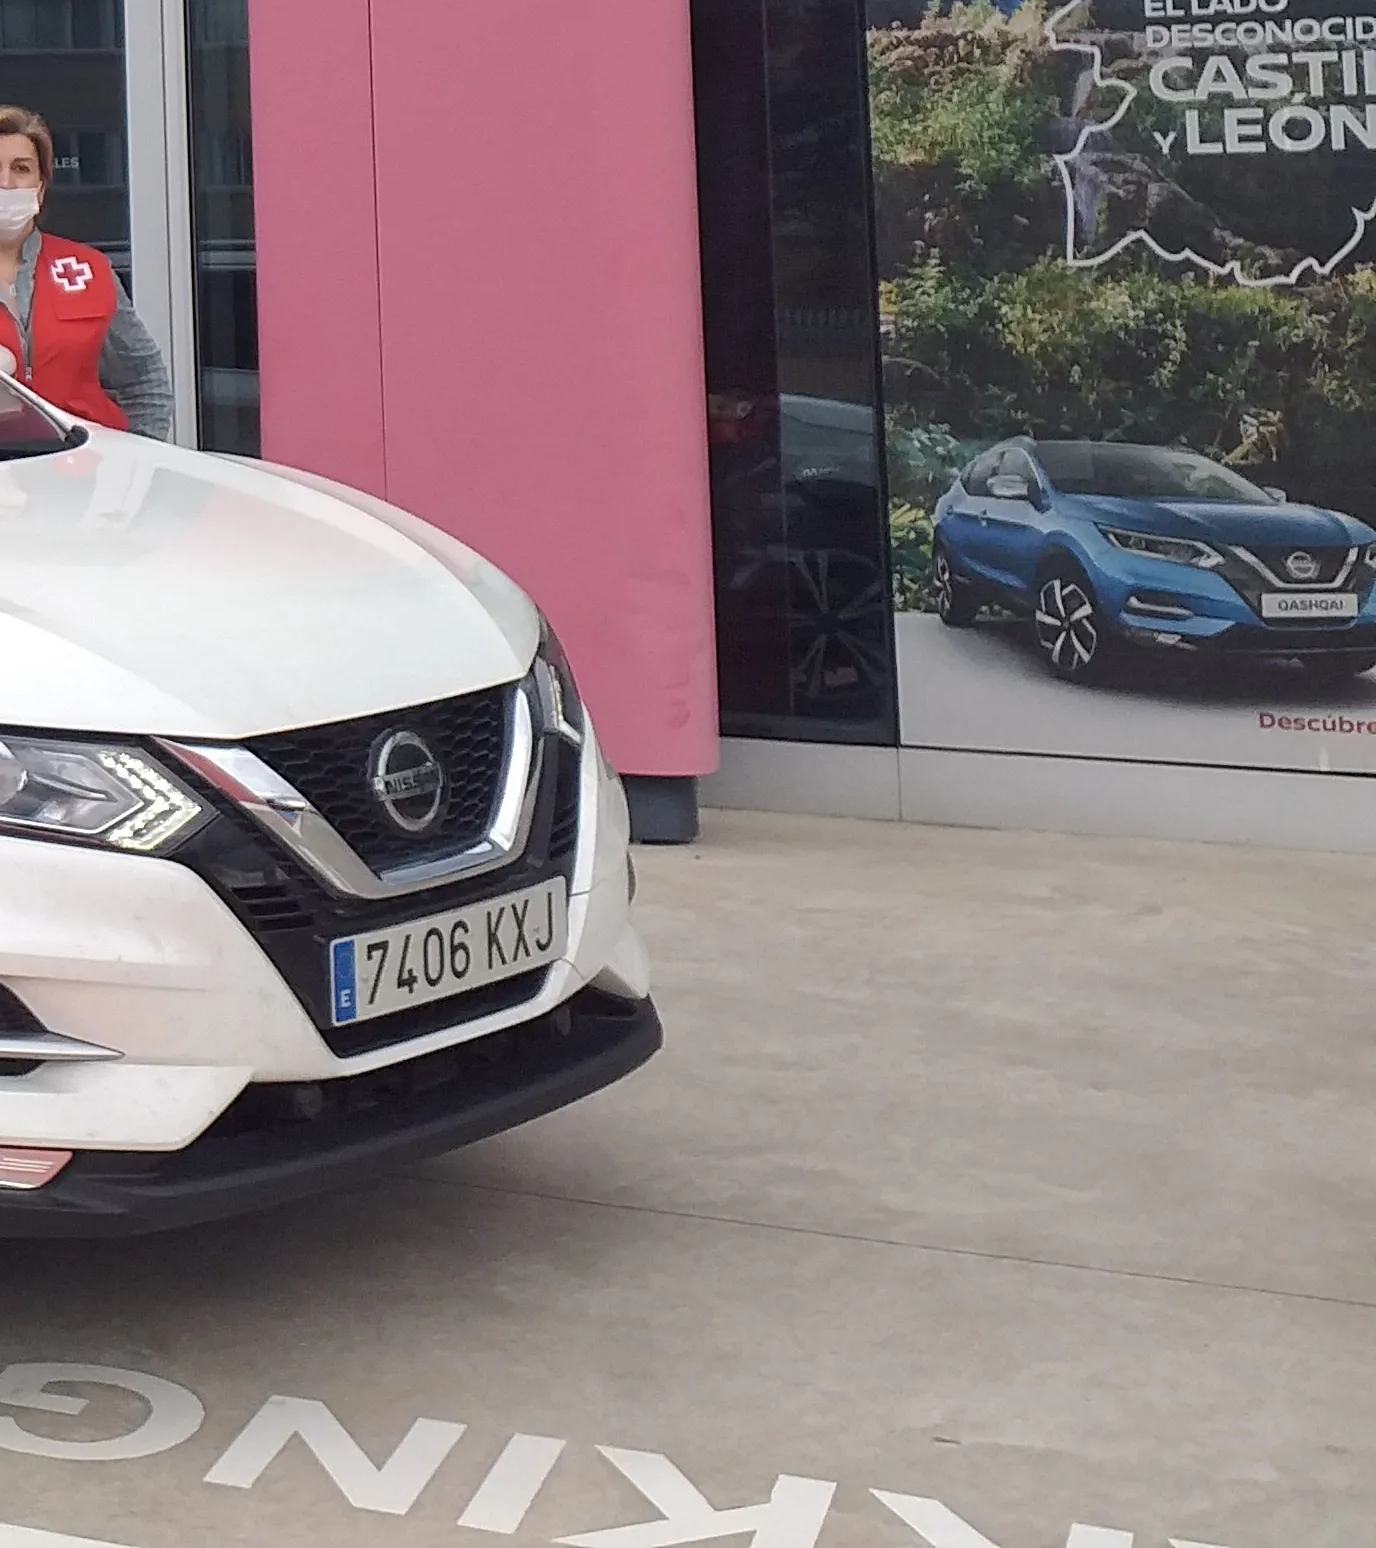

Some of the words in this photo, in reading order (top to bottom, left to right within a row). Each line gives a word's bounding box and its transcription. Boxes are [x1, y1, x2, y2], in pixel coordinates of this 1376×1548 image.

[1145, 16, 1376, 48] DESCONOCID
[1153, 131, 1177, 155] Y
[1185, 93, 1376, 155] LEÓN
[1278, 599, 1344, 612] QASHQAI
[367, 919, 471, 1006] 7406
[486, 892, 553, 970] KXJ
[340, 989, 351, 1009] E
